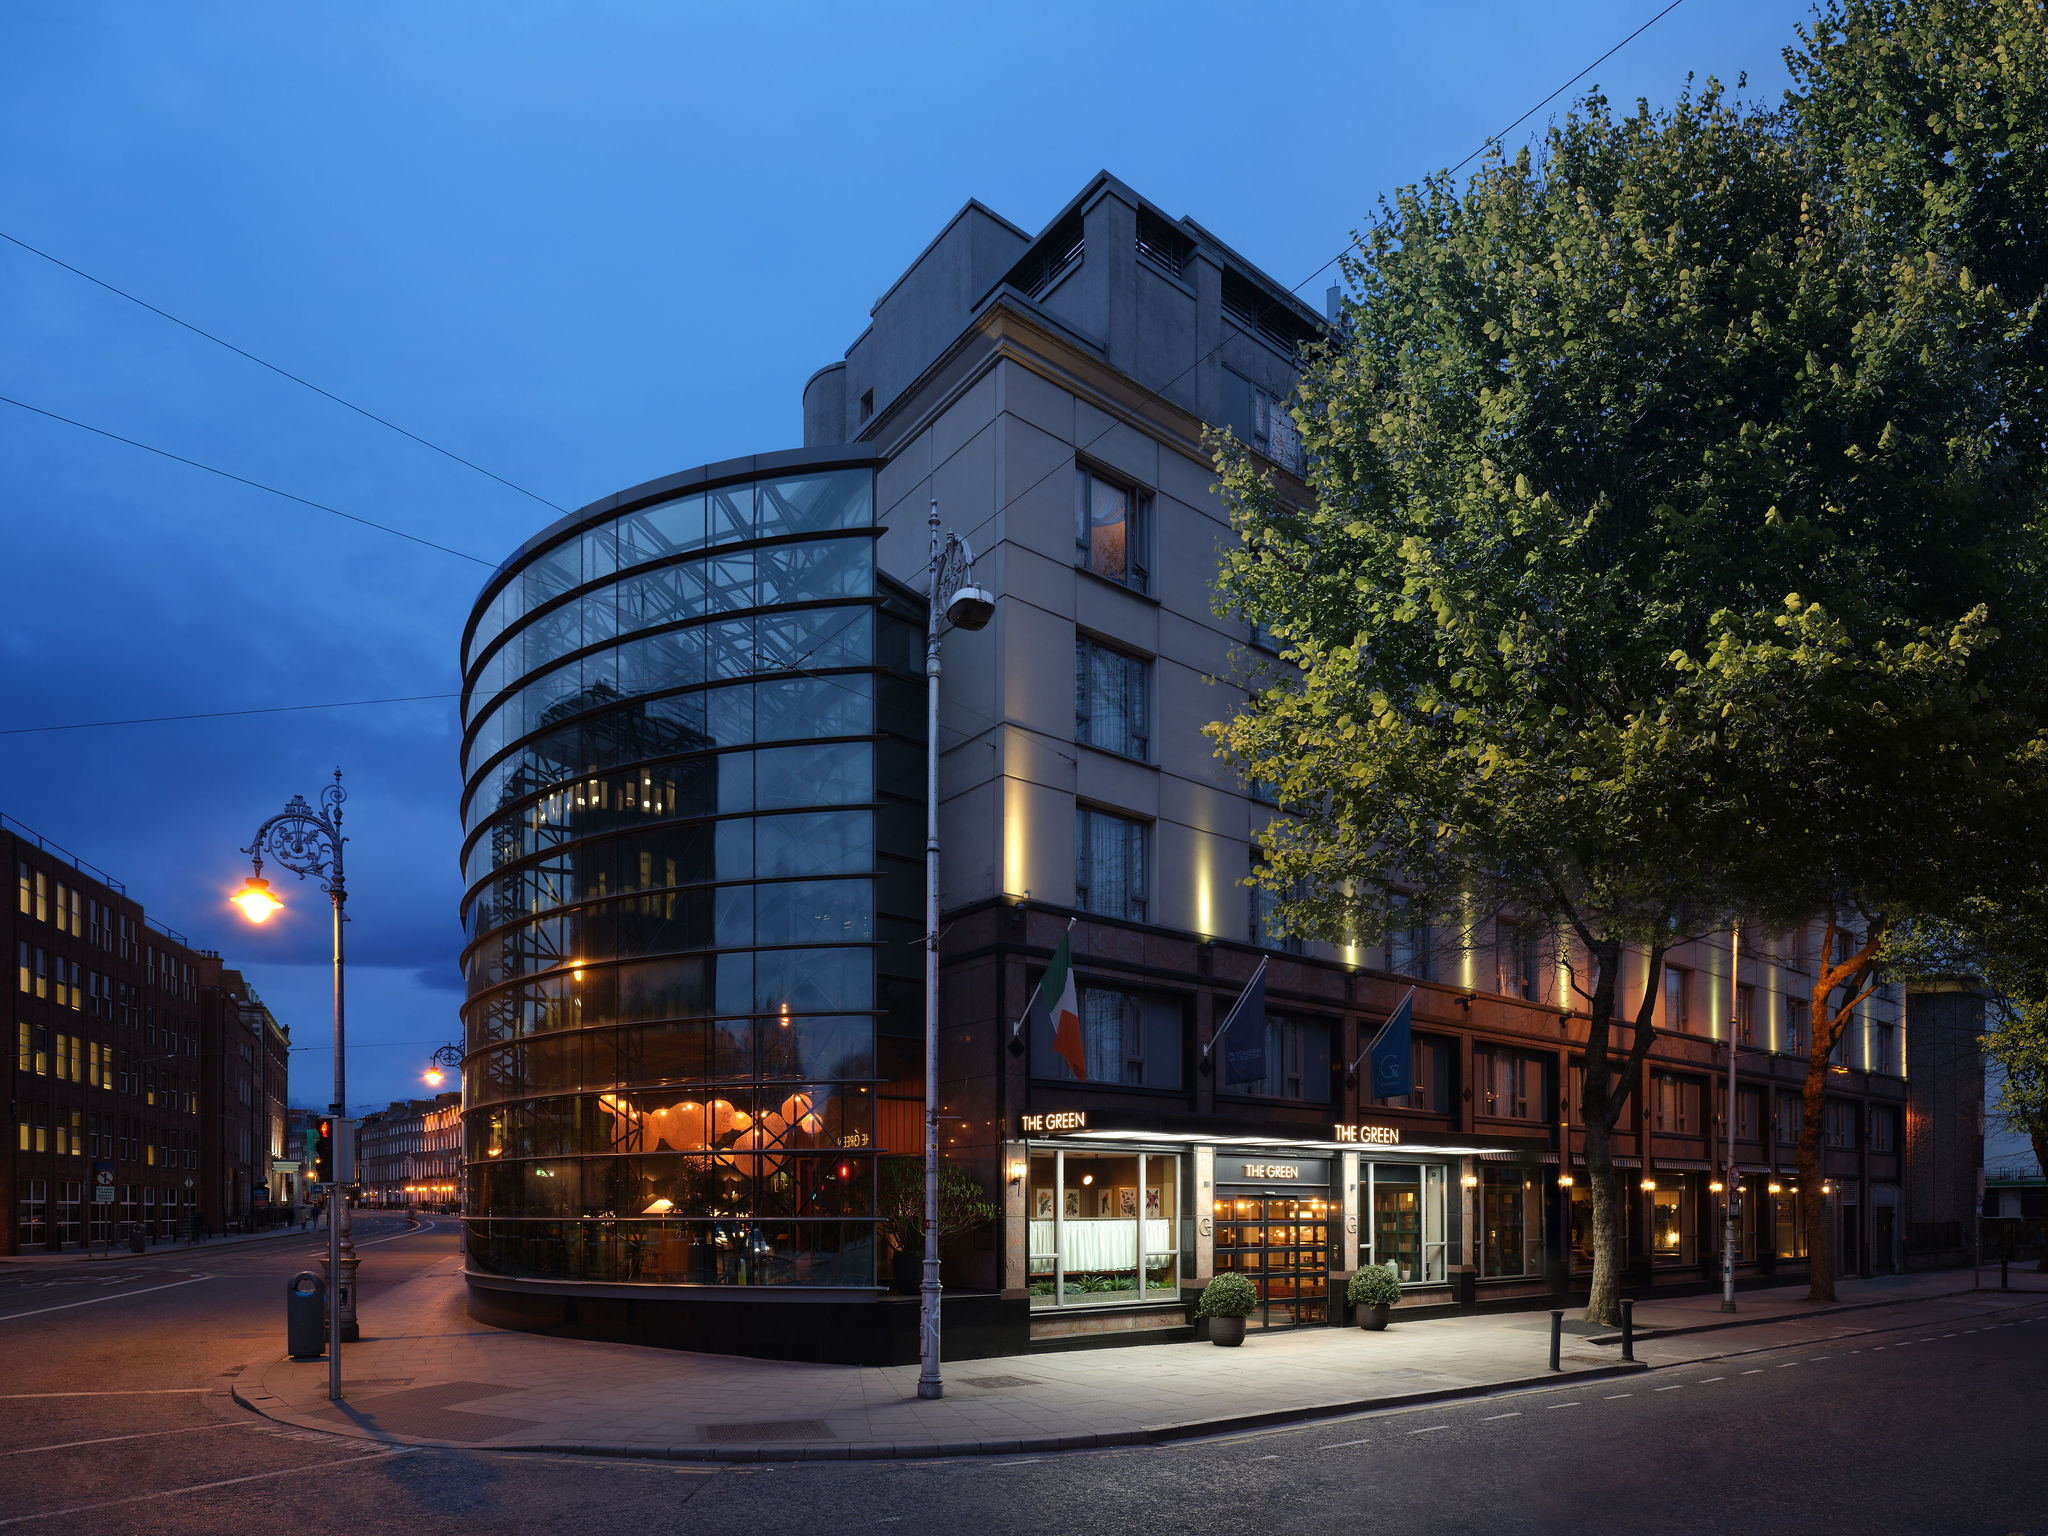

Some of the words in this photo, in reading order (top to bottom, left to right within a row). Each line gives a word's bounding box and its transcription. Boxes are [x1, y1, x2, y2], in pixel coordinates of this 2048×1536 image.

[1021, 1114, 1043, 1131] THE
[1045, 1111, 1085, 1130] GREEN
[1334, 1124, 1357, 1141] THE
[1360, 1126, 1399, 1144] GREEN
[1245, 1164, 1265, 1177] THE
[1267, 1165, 1298, 1178] GREEN
